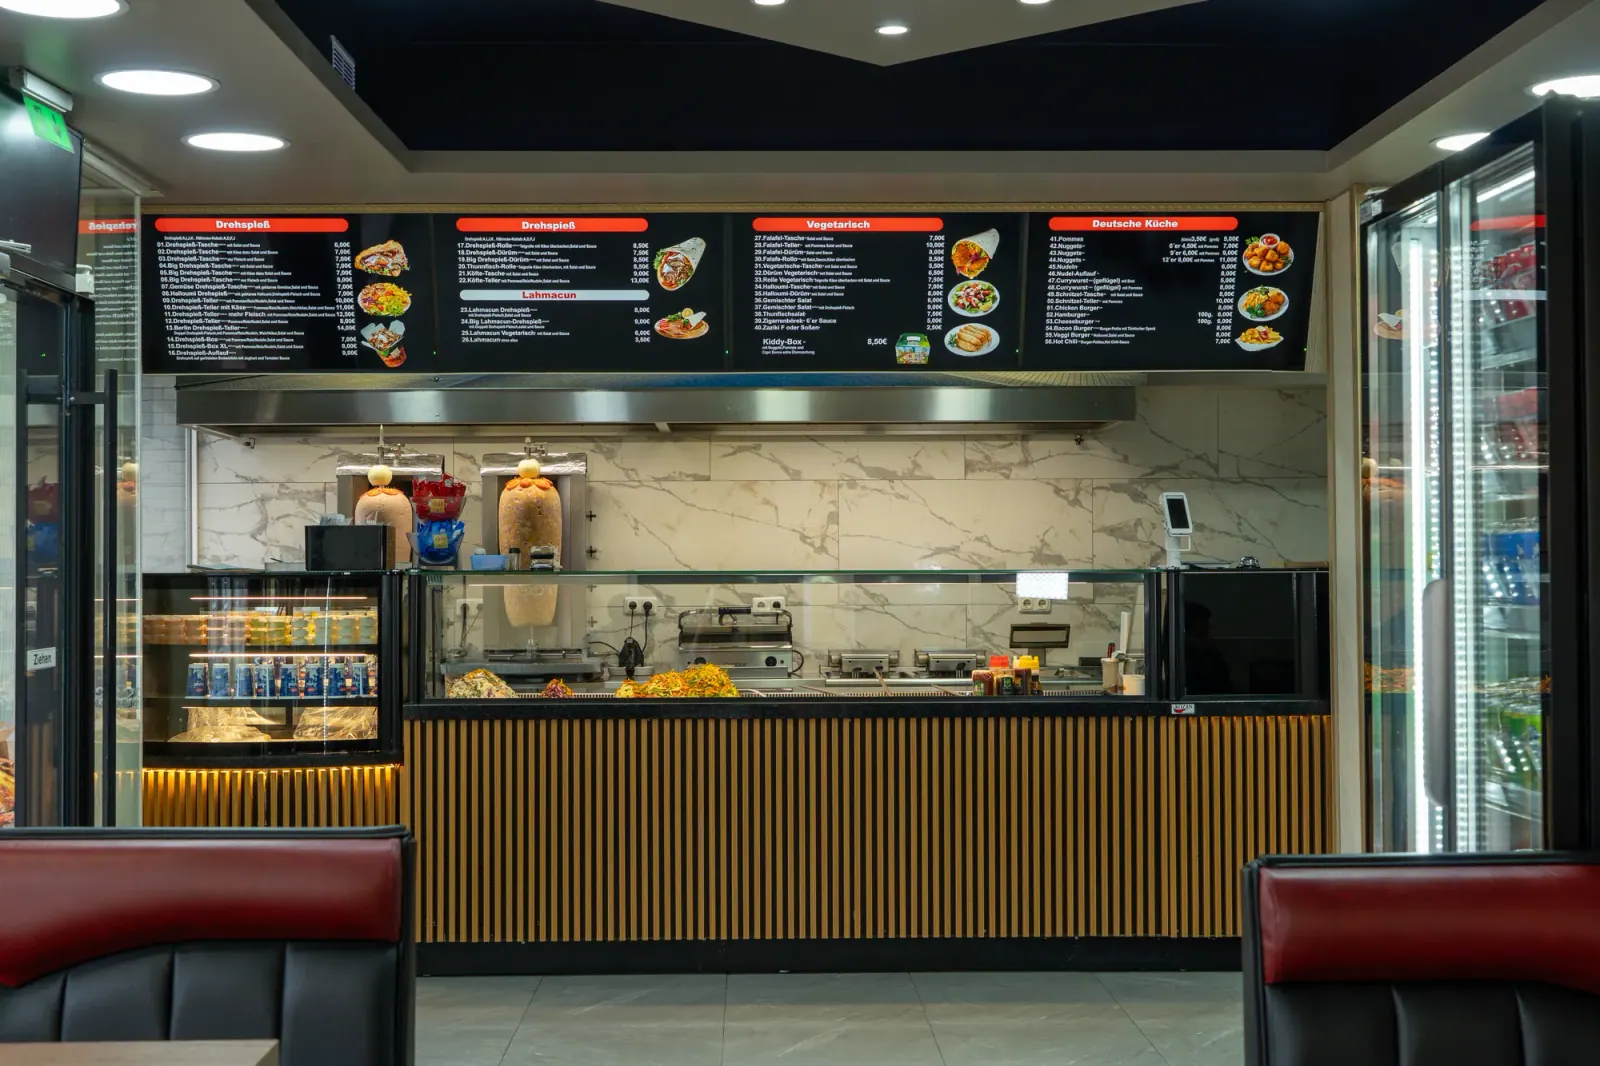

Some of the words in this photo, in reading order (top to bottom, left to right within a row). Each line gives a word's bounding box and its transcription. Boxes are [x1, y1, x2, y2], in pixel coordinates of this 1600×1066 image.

[216, 220, 270, 230] Drehspieß
[522, 221, 576, 231] Drehspieß
[806, 220, 870, 230] Vegetarisch
